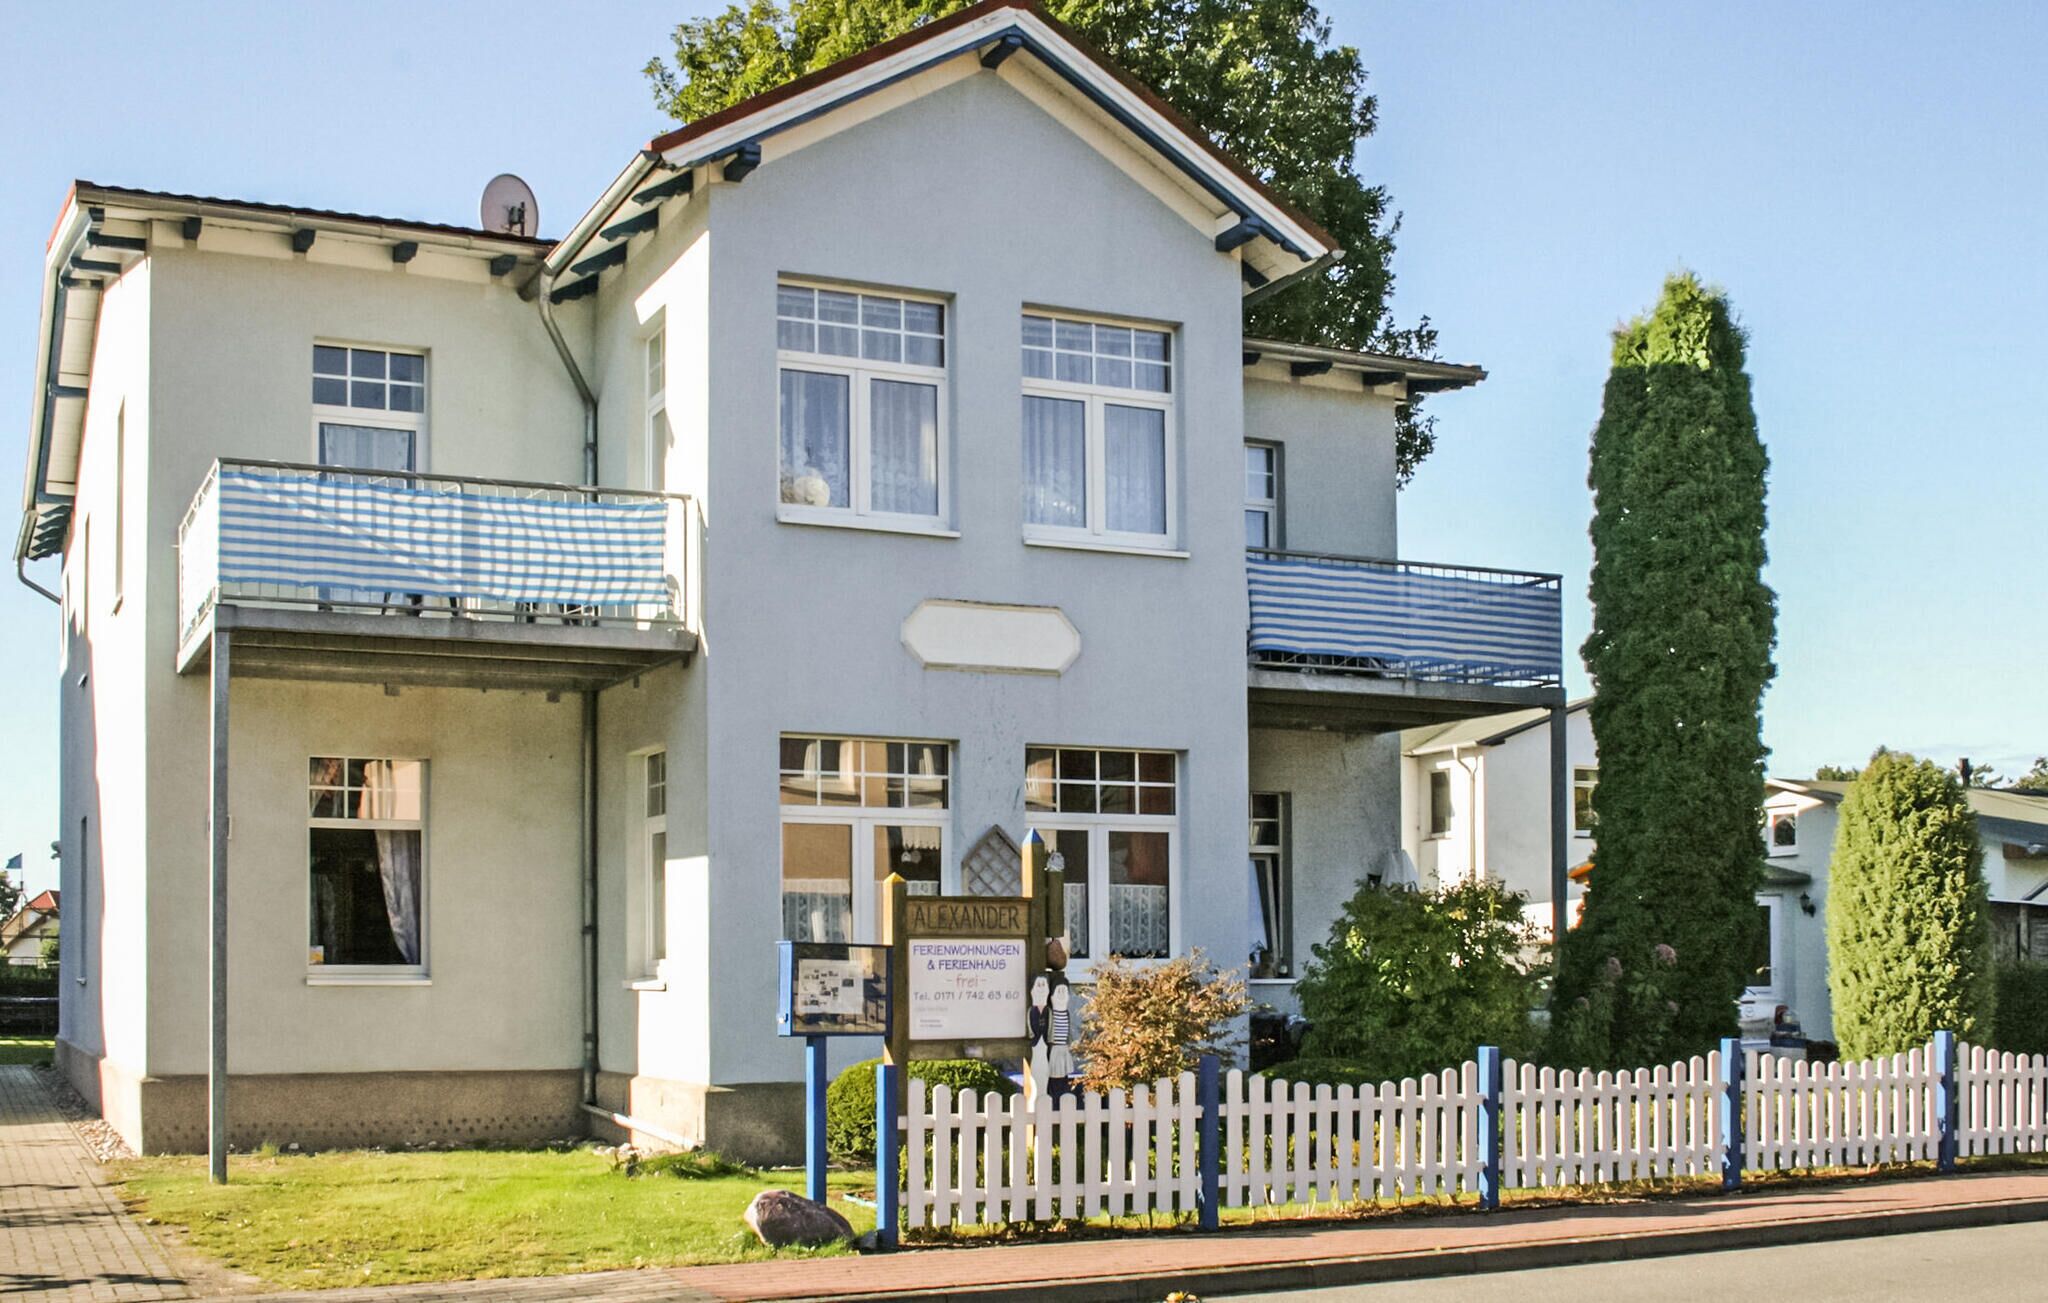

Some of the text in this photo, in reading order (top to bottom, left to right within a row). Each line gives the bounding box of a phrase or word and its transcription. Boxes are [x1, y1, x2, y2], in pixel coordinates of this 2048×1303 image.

[914, 905, 1020, 930] ALEXANDER
[913, 944, 1020, 956] FERIENWOHNUNGEN
[927, 959, 1006, 970] & FERIENHAUS
[956, 973, 979, 989] frei
[914, 991, 930, 1001] Tel.
[934, 991, 955, 1001] 0171
[958, 991, 963, 1001] /
[965, 991, 985, 1001] 742
[1005, 991, 1020, 1001] 60
